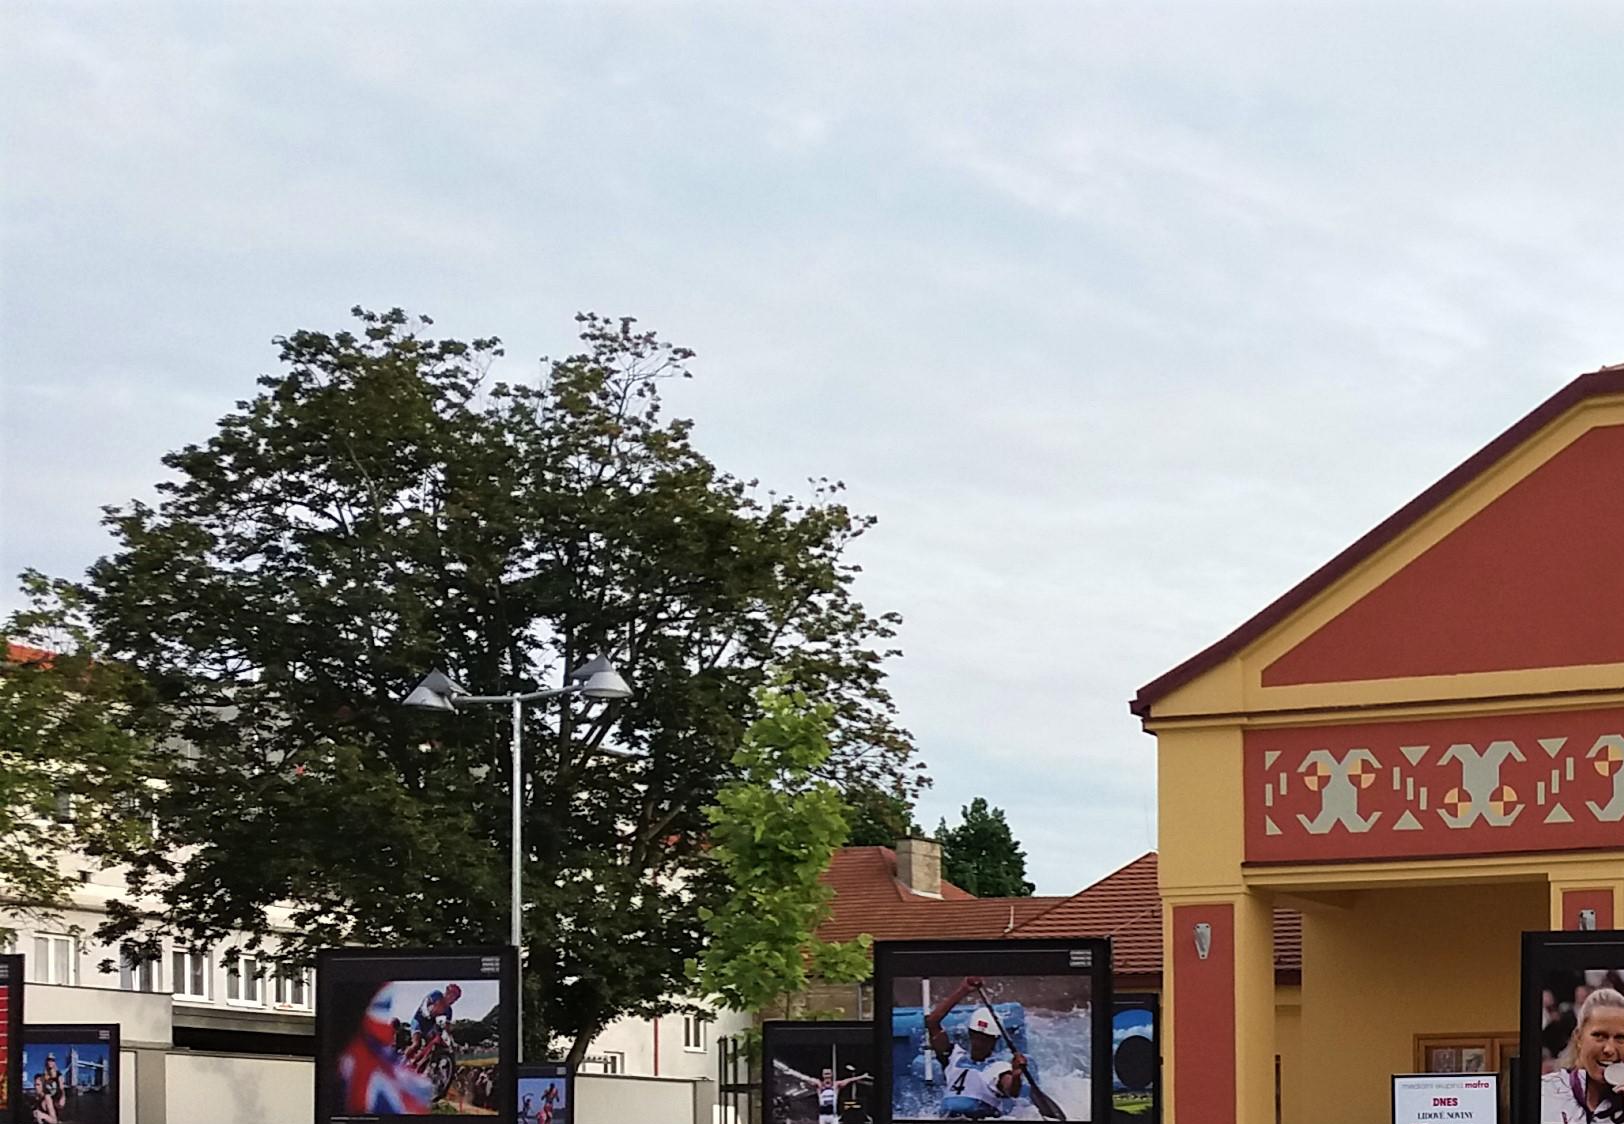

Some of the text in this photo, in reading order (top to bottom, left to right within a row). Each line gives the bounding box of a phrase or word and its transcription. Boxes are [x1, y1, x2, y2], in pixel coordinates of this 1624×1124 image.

[951, 1069, 968, 1095] 4
[1465, 1080, 1489, 1088] mafra
[1433, 1098, 1458, 1106] DNES
